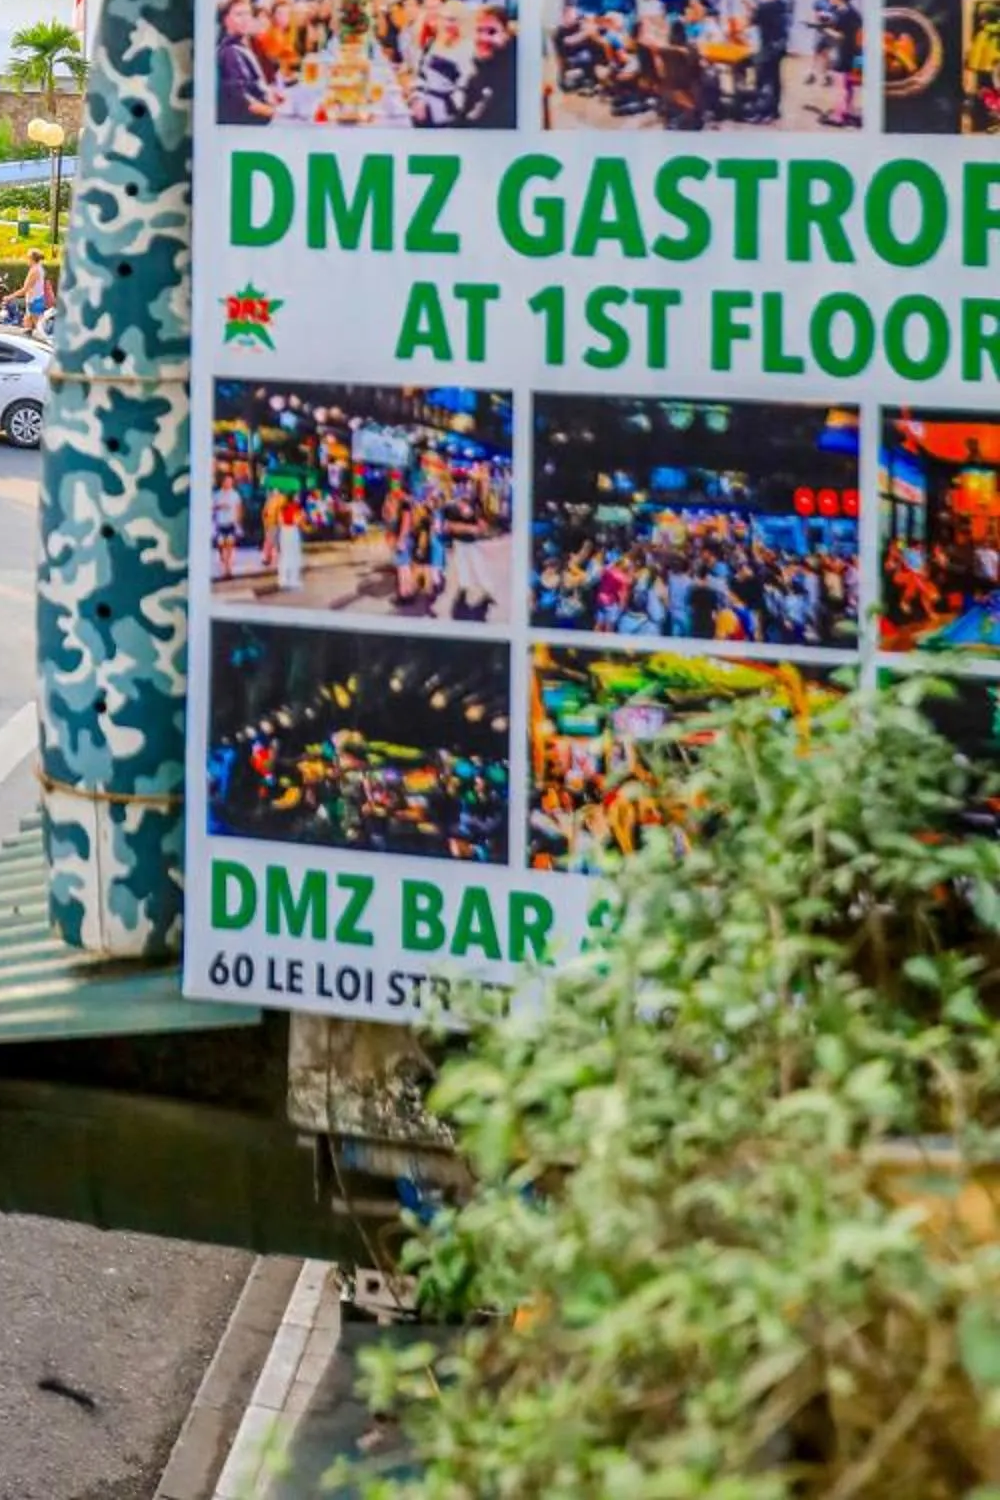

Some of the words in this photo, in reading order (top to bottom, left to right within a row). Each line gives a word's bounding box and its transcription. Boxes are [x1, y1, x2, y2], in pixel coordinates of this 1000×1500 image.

[231, 152, 460, 254] DMZ
[397, 283, 499, 361] AT
[530, 287, 681, 368] 1ST
[712, 292, 1000, 380] FLOOR
[212, 860, 374, 946] DMZ
[402, 880, 555, 966] BAR
[209, 951, 253, 987] 60
[266, 956, 303, 994] LE
[317, 962, 373, 1003] LOI
[387, 969, 514, 1017] STRT
